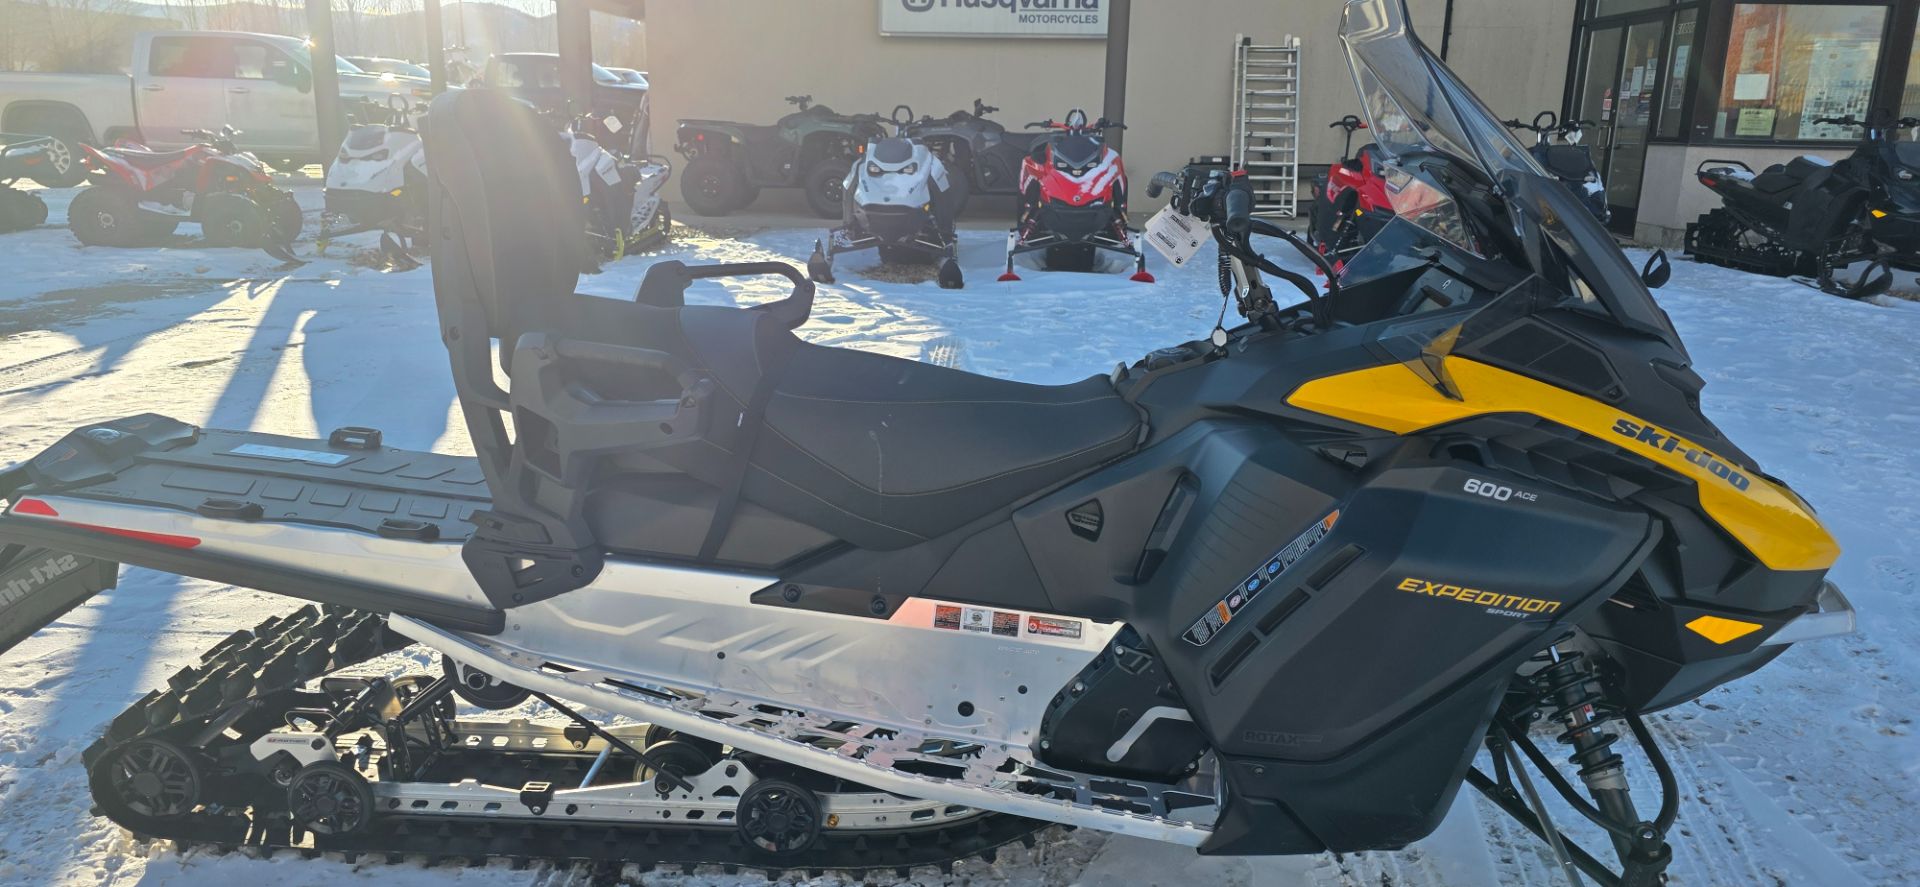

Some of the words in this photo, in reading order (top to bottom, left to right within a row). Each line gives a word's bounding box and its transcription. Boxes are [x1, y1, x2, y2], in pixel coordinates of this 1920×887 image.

[1018, 14, 1098, 24] MOTORCYCLES
[1611, 418, 1750, 491] ski-doo
[1463, 478, 1513, 502] 600
[1513, 490, 1538, 502] ACE
[1396, 577, 1562, 613] EXPEDITION
[1485, 607, 1531, 619] SPORT
